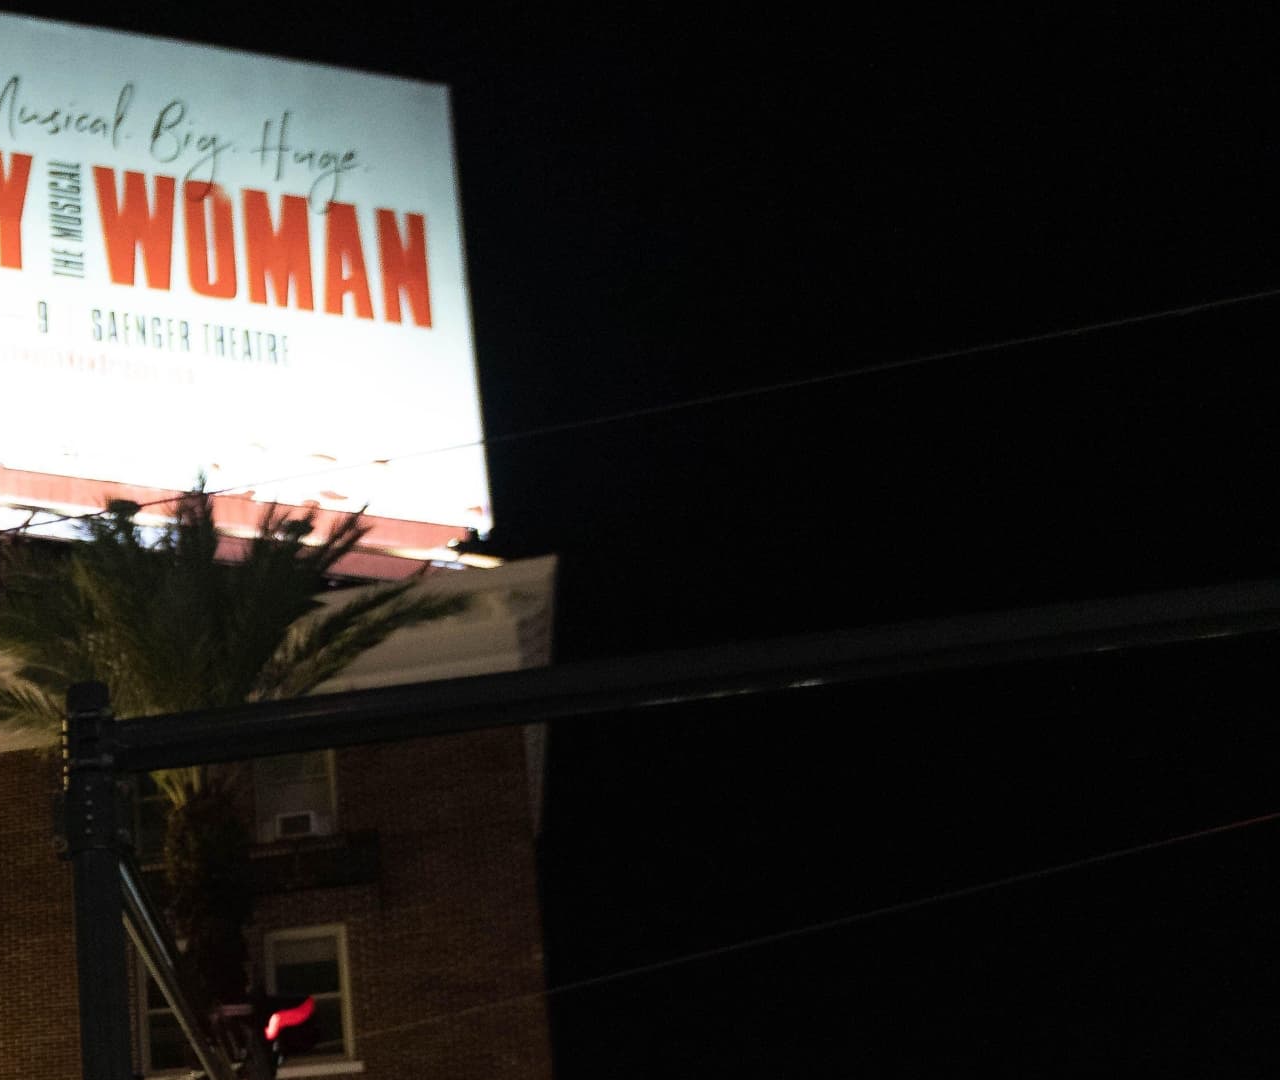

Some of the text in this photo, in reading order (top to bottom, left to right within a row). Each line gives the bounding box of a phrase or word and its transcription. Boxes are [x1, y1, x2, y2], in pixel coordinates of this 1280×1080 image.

[48, 161, 85, 279] THE MUSICAL
[92, 166, 432, 328] WOMAN
[37, 301, 48, 333] 9
[92, 309, 190, 352] SAENGER
[203, 324, 290, 365] THEATRE
